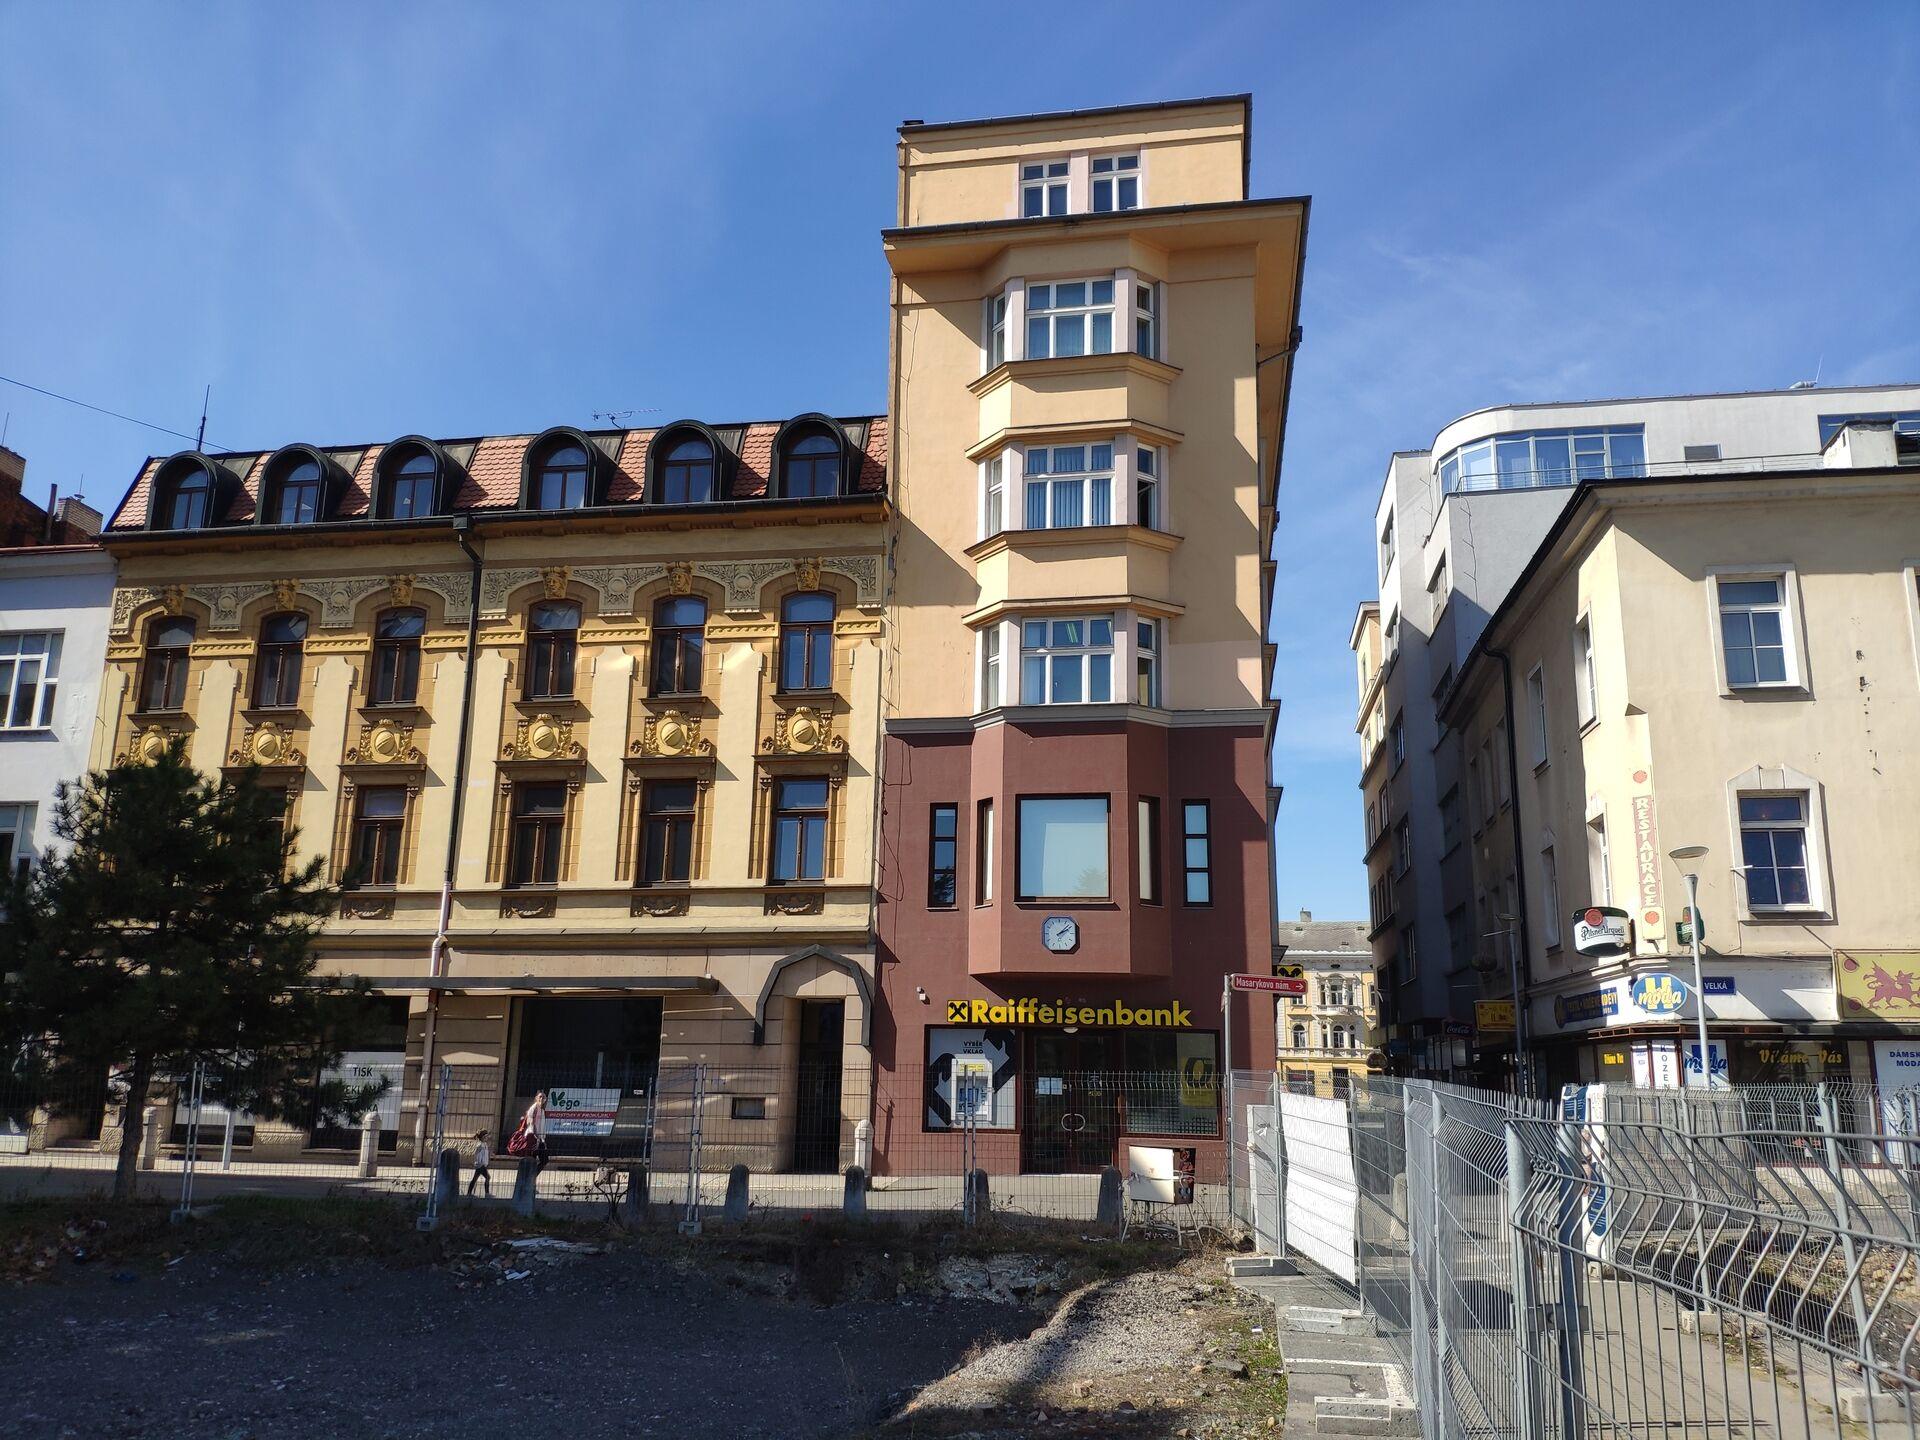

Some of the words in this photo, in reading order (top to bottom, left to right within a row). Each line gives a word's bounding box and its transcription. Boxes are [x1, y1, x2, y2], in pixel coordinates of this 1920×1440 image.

[1635, 798, 1656, 906] RESTAURACE
[1581, 926, 1603, 941] Pilsner
[1603, 925, 1625, 936] Urquell
[1236, 977, 1274, 990] Masarykovo
[1275, 980, 1291, 990] nám.
[1704, 981, 1728, 990] VELKÁ
[971, 998, 1192, 1027] Raiffeisenbank
[1684, 1051, 1727, 1070] mda
[1818, 1049, 1842, 1064] Vás
[353, 1067, 373, 1077] TISK
